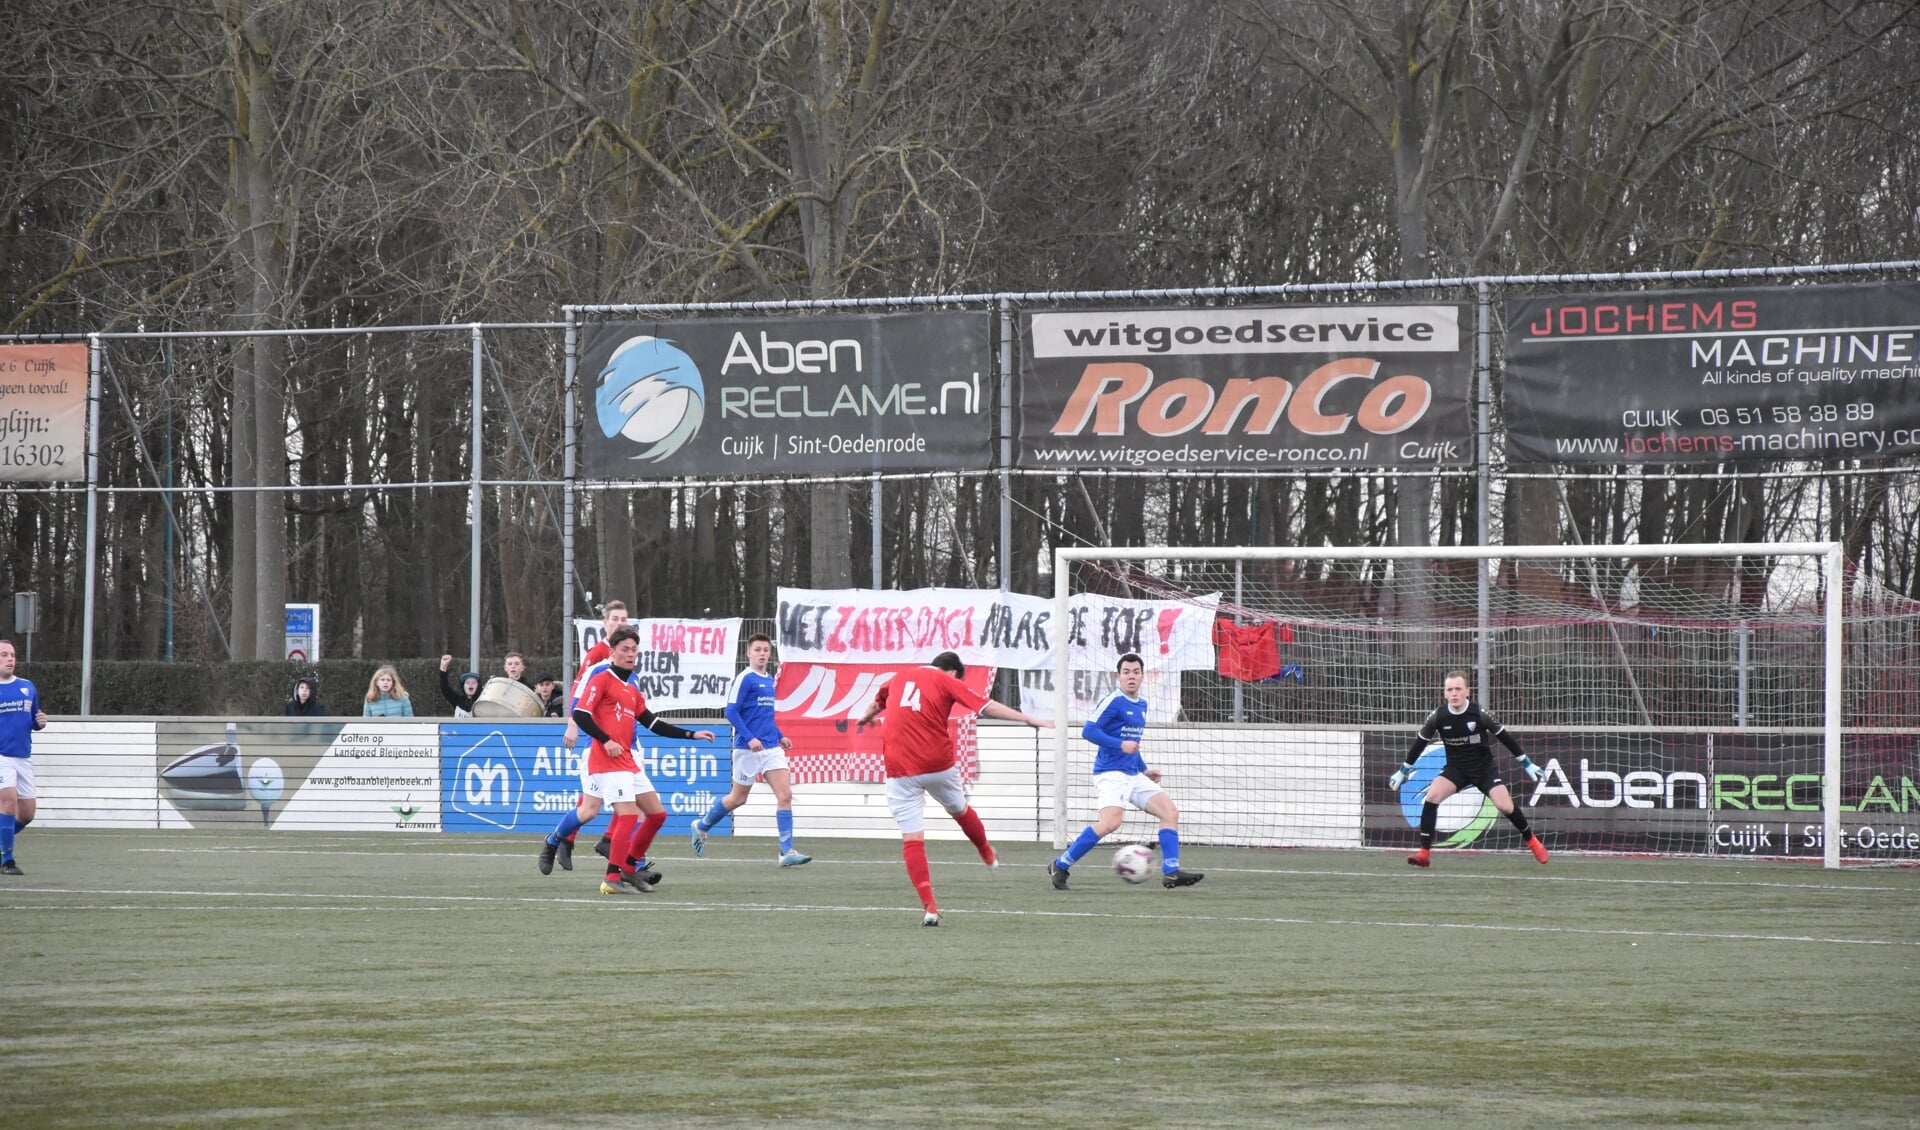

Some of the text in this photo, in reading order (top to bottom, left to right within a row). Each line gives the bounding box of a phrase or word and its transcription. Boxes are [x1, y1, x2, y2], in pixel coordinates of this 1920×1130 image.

[1530, 300, 1758, 336] JOCHEMS
[1063, 317, 1435, 353] witgoedservice
[720, 331, 862, 375] Aben
[10, 360, 17, 372] 6
[25, 357, 56, 377] Cuijk
[1701, 371, 1722, 384] All
[1726, 370, 1772, 384] kinds
[1776, 368, 1795, 383] of
[1798, 367, 1857, 385] quality
[29, 380, 68, 394] toeval!
[721, 372, 980, 418] RECLAME.nl
[1049, 358, 1433, 436] RonCo
[1622, 403, 1874, 427] CUIJK 06 51 58 38 89
[2, 444, 64, 466] 16302
[721, 433, 926, 459] Cuijk Sint-Oedenrode
[1033, 441, 1459, 467] www.witgoedservice-ronco.nl Cuijk
[652, 623, 727, 655] HARTEN
[900, 681, 921, 712] 4
[334, 747, 433, 759] Landgoed Bleijenbeek!
[341, 734, 384, 746] Golfen op
[532, 746, 718, 785] Alb Heijn
[1529, 757, 1707, 809] Aben
[671, 790, 718, 817] Cuijk
[1715, 824, 1920, 852] Cuijk Sit-Oede
